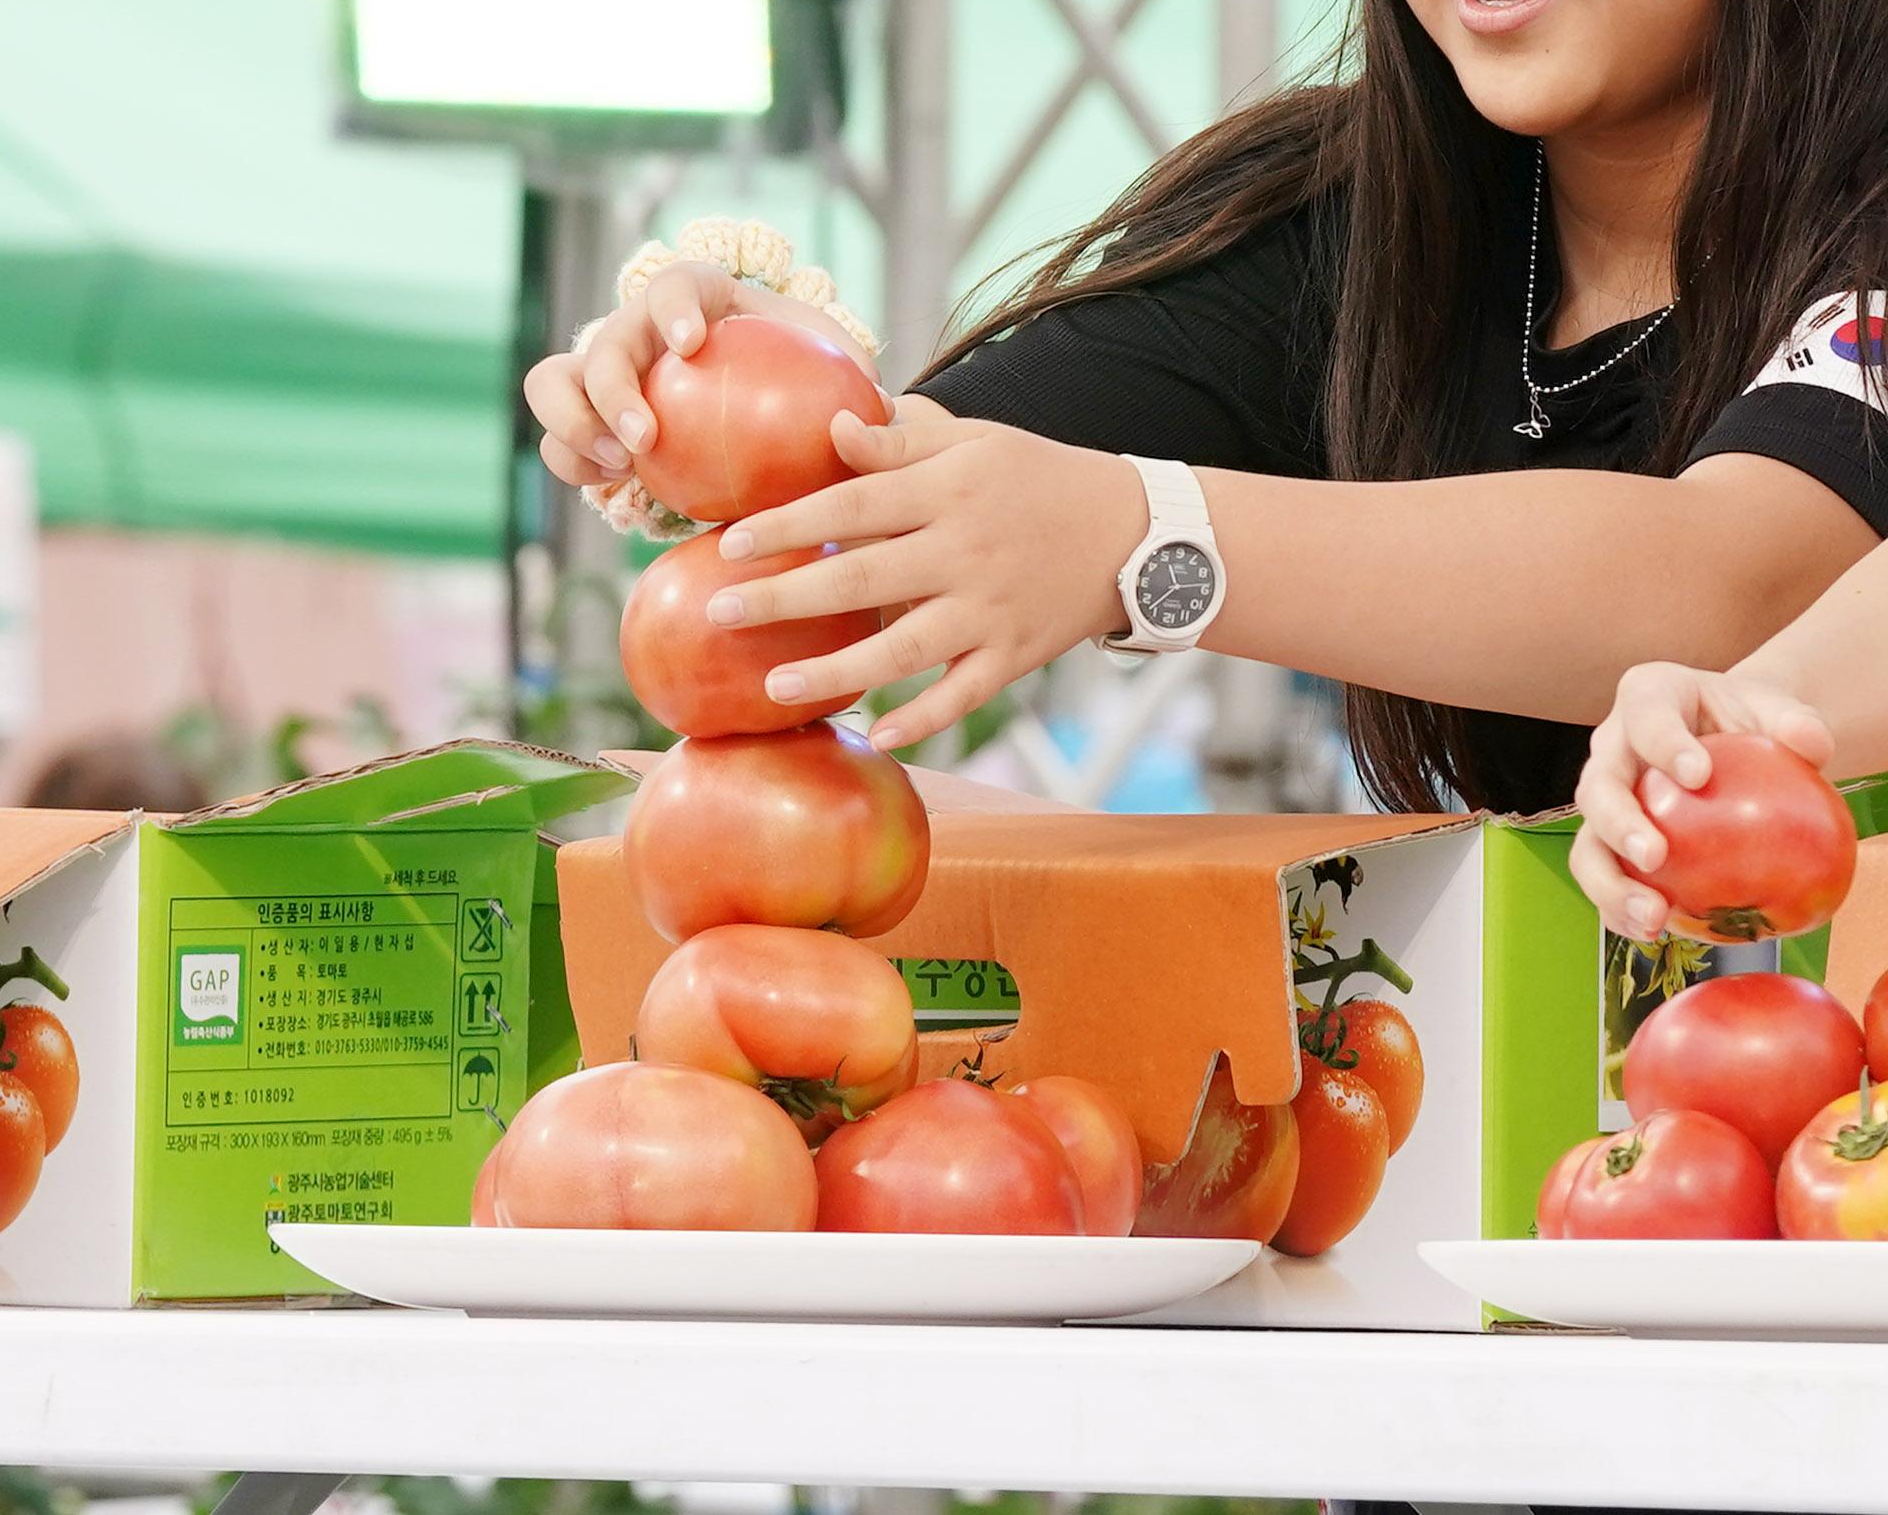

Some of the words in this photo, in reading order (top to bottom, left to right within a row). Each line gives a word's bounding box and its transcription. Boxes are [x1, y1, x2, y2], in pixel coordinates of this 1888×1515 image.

[258, 903, 313, 924] 인증품의
[318, 900, 374, 923] 표시사항
[190, 969, 229, 991] GAP
[317, 963, 348, 980] 토마토
[317, 989, 347, 1006] 경기도
[352, 987, 382, 1005] 광주시
[317, 1012, 339, 1030] 경기도
[342, 1012, 366, 1029] 광주시
[244, 1088, 295, 1104] 1018092
[166, 1134, 198, 1153] 포장재
[199, 1132, 220, 1151] 규격
[288, 1170, 394, 1194] 광주시농업기술센터
[288, 1200, 393, 1222] 광주토마토연구회
